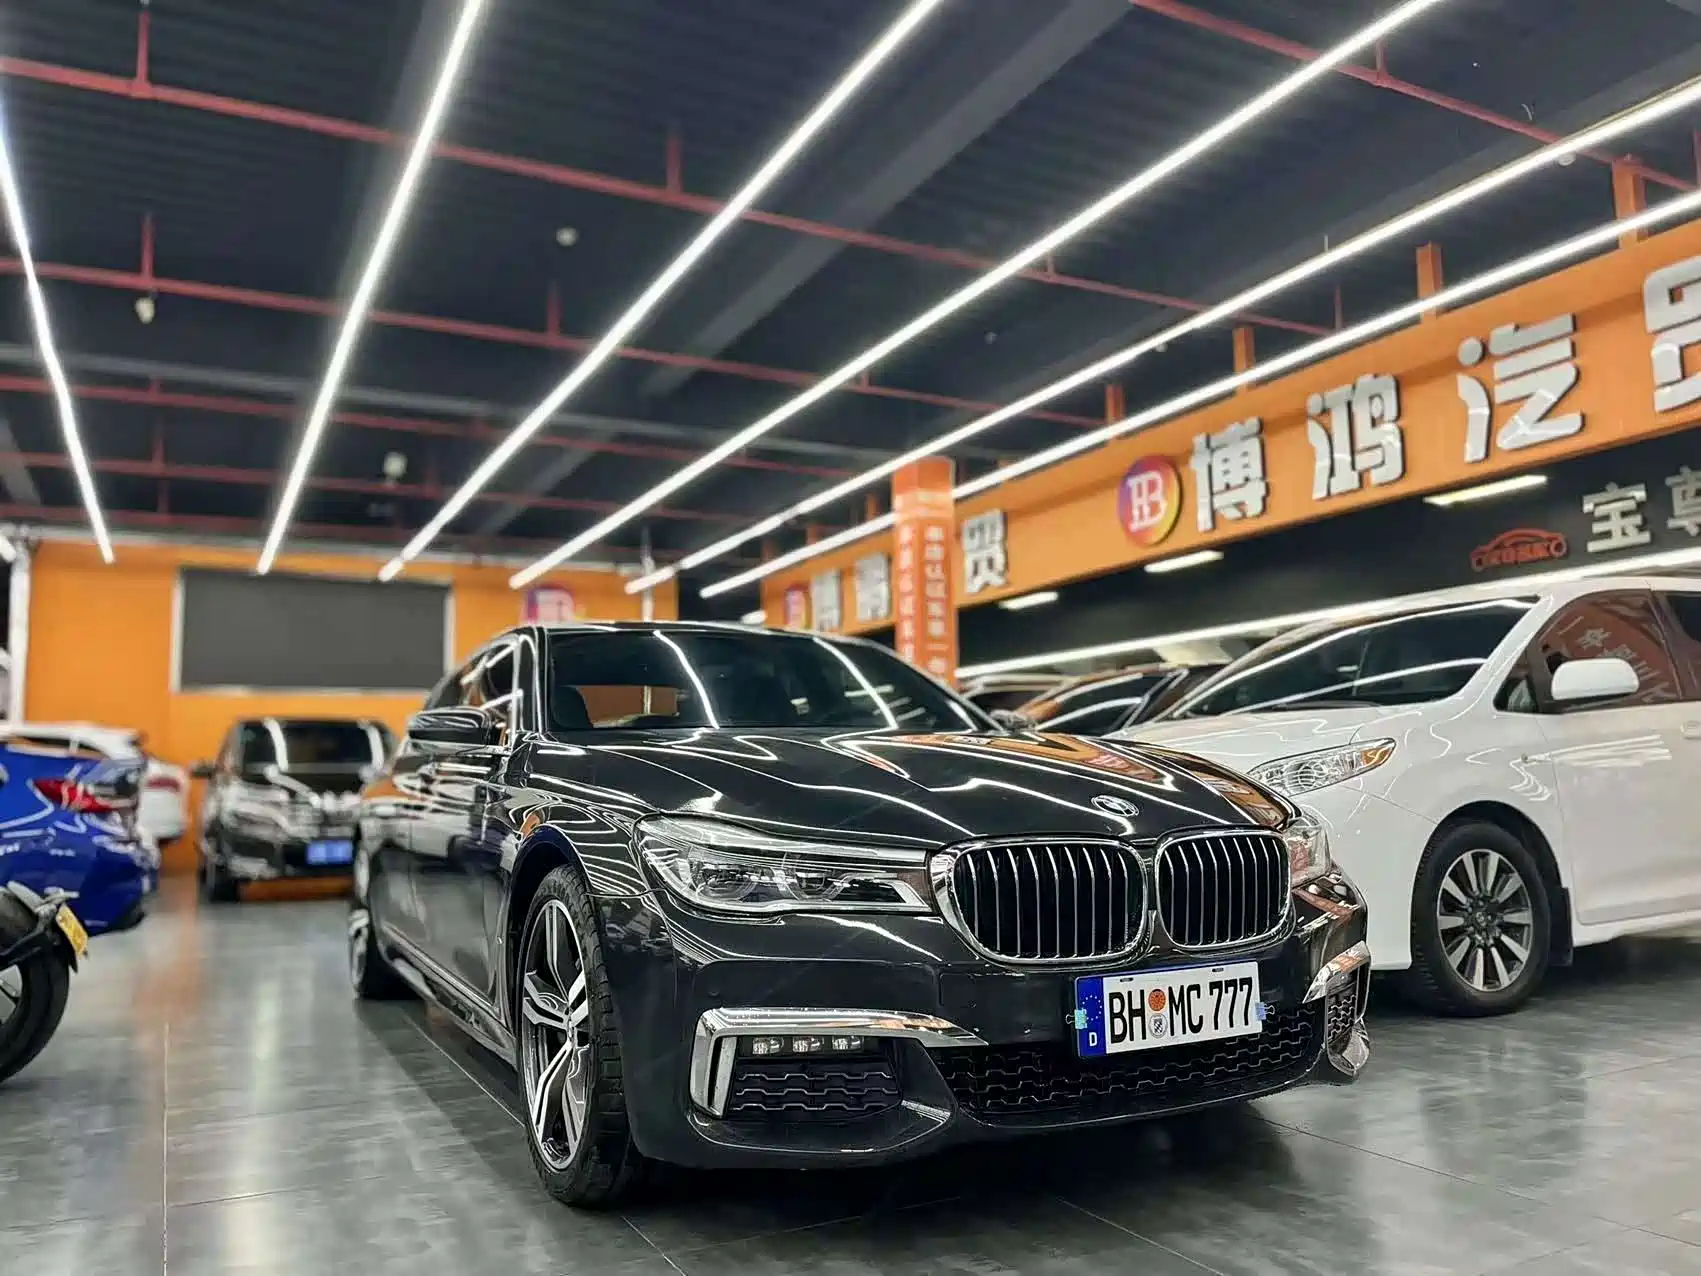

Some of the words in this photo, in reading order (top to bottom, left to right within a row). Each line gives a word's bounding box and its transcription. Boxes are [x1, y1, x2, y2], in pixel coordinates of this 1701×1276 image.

[1088, 1031, 1098, 1047] D
[1109, 989, 1147, 1044] BH
[1168, 983, 1204, 1036] MC
[1209, 976, 1253, 1030] 777
